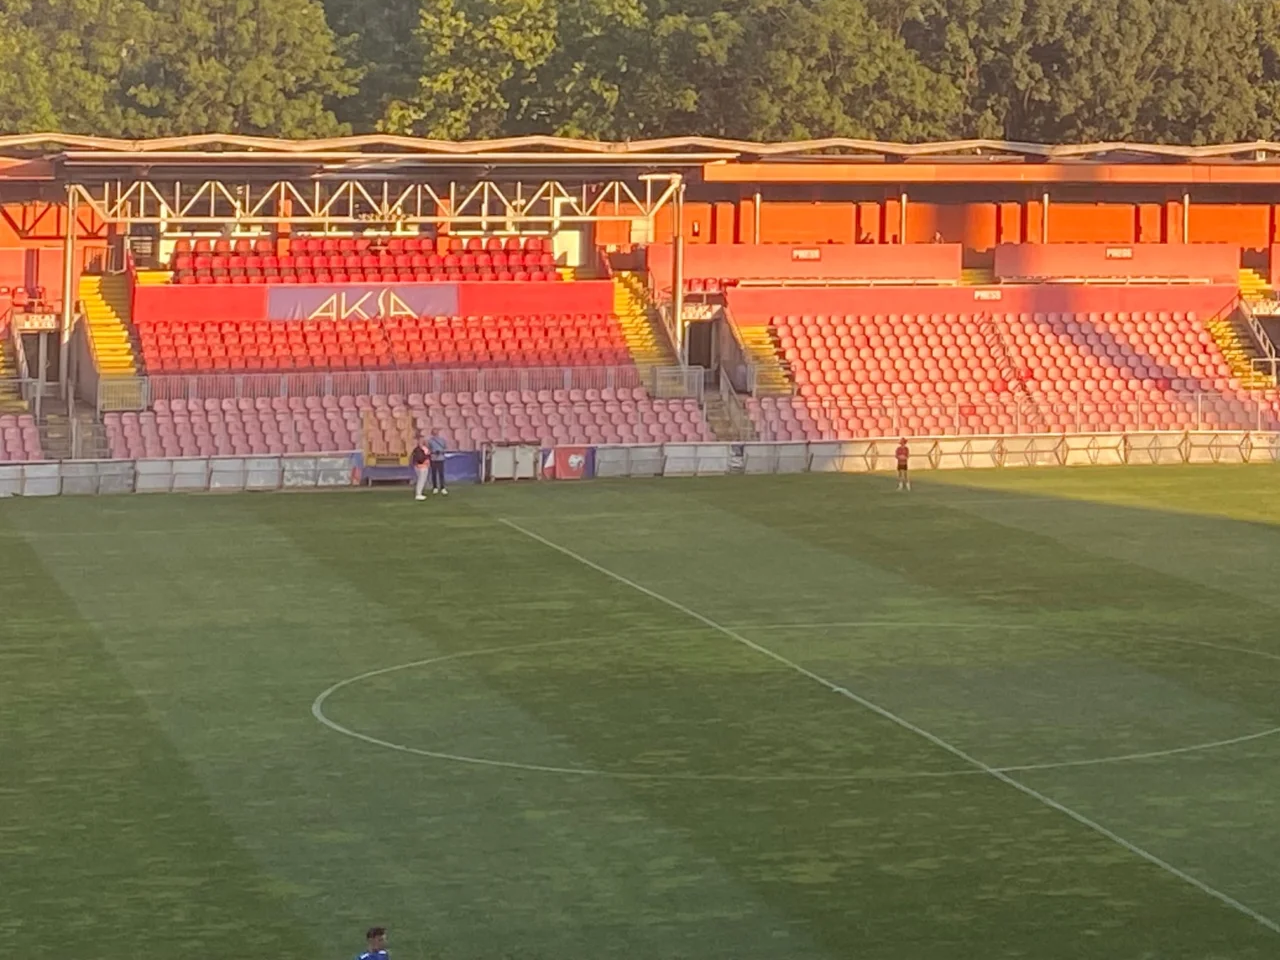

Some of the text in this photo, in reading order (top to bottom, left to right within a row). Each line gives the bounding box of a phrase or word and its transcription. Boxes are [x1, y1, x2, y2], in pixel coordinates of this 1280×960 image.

[792, 248, 820, 260] PRESS
[1106, 247, 1132, 259] PRESS
[974, 290, 1001, 301] PRESS
[307, 287, 418, 321] AKSA
